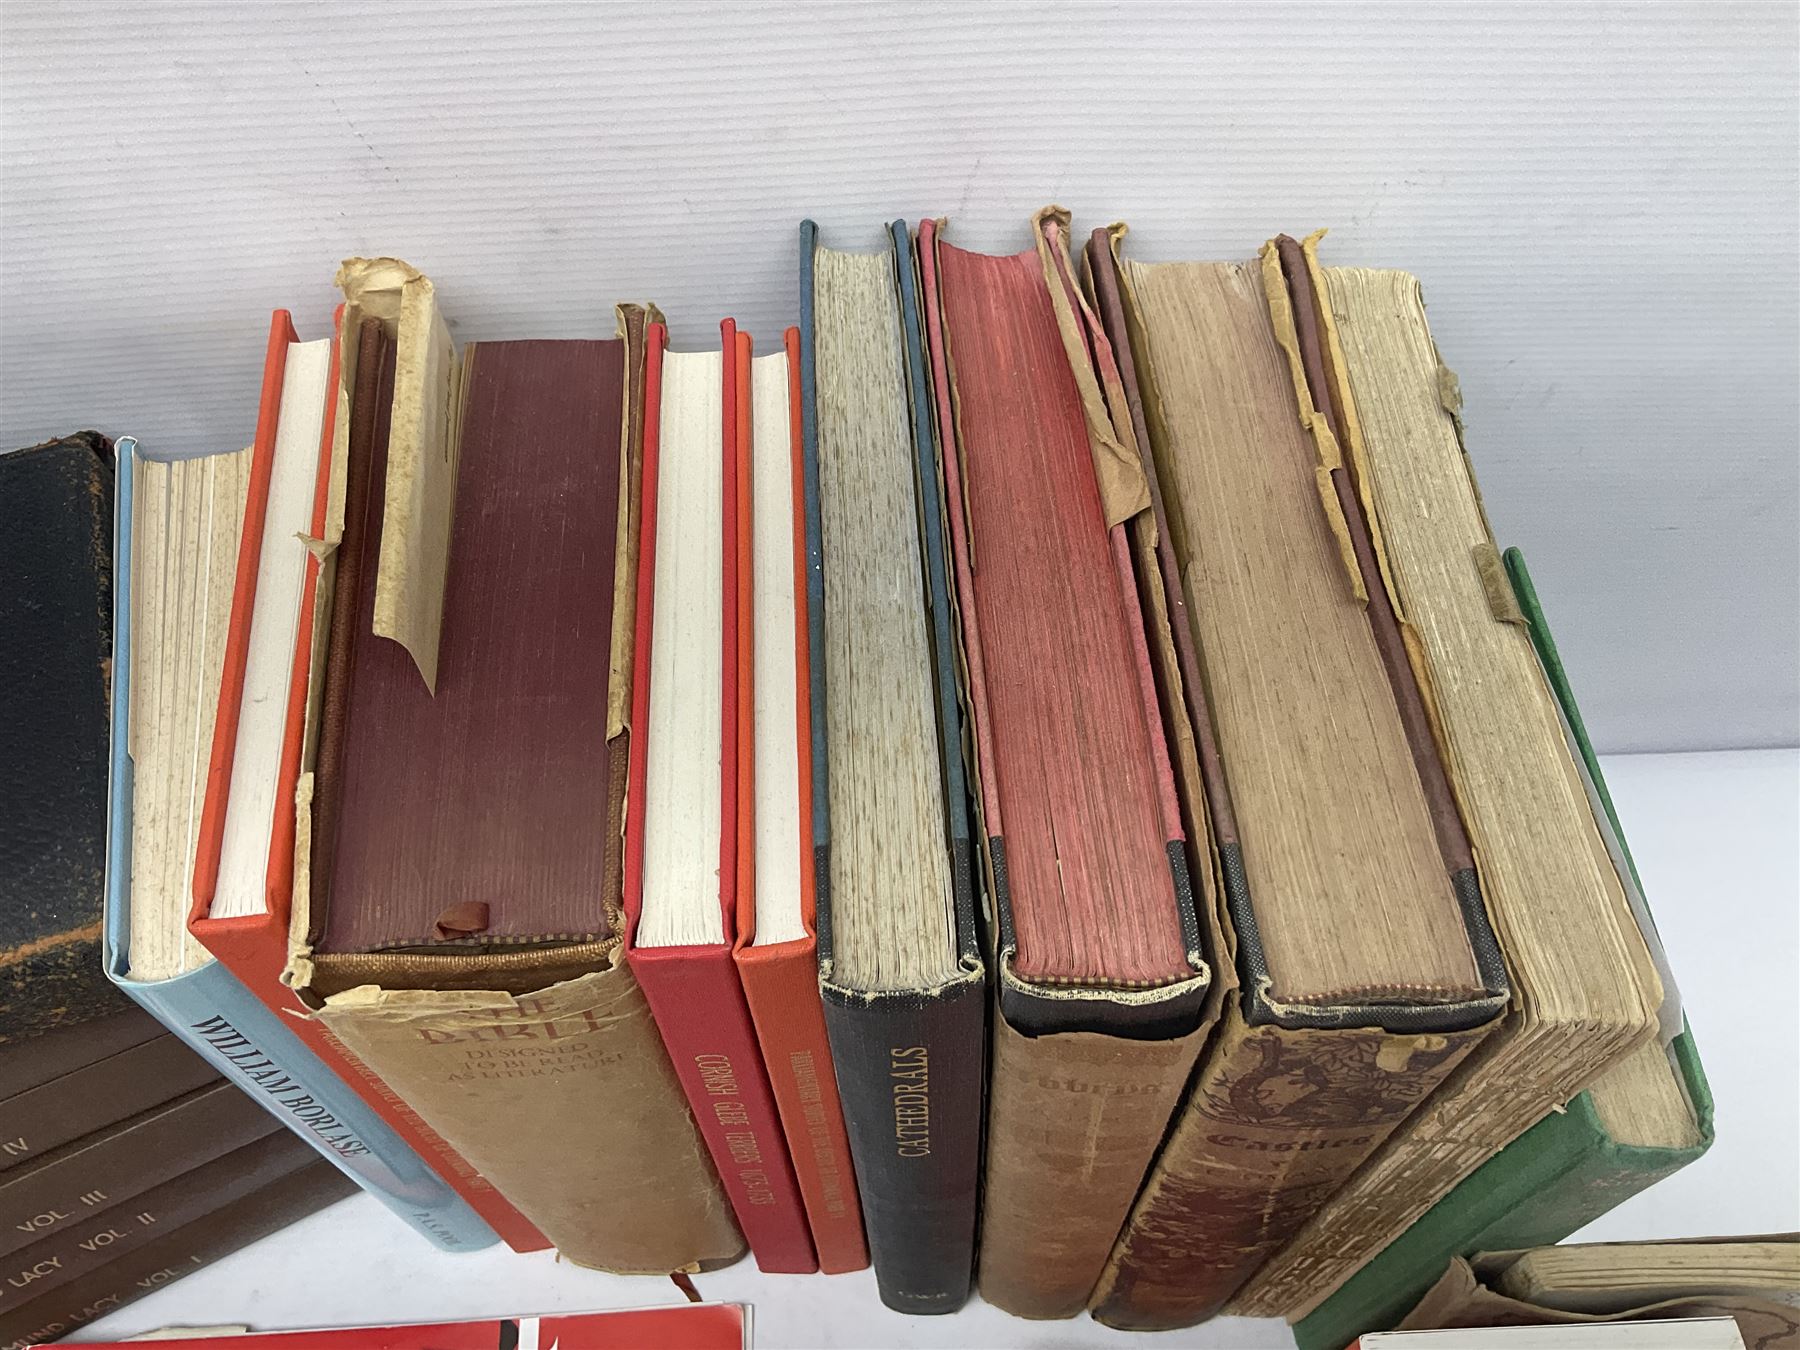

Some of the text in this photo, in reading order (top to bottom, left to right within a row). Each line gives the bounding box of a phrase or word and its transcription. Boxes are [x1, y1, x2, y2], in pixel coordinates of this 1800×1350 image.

[190, 1014, 372, 1158] WILLIAM BORLASE
[449, 1071, 475, 1081] AS
[464, 1060, 496, 1071] TO
[694, 1054, 739, 1096] CORNISH
[712, 1101, 750, 1126] GLEBE
[889, 1046, 930, 1157] CATHEDRALS
[2, 1137, 29, 1156] IV
[724, 1130, 763, 1164] TERRIERS
[16, 1189, 108, 1232] VOL. III
[7, 1211, 157, 1287] LACY VOL. II
[69, 1293, 121, 1322] LACY
[190, 1254, 202, 1264] I
